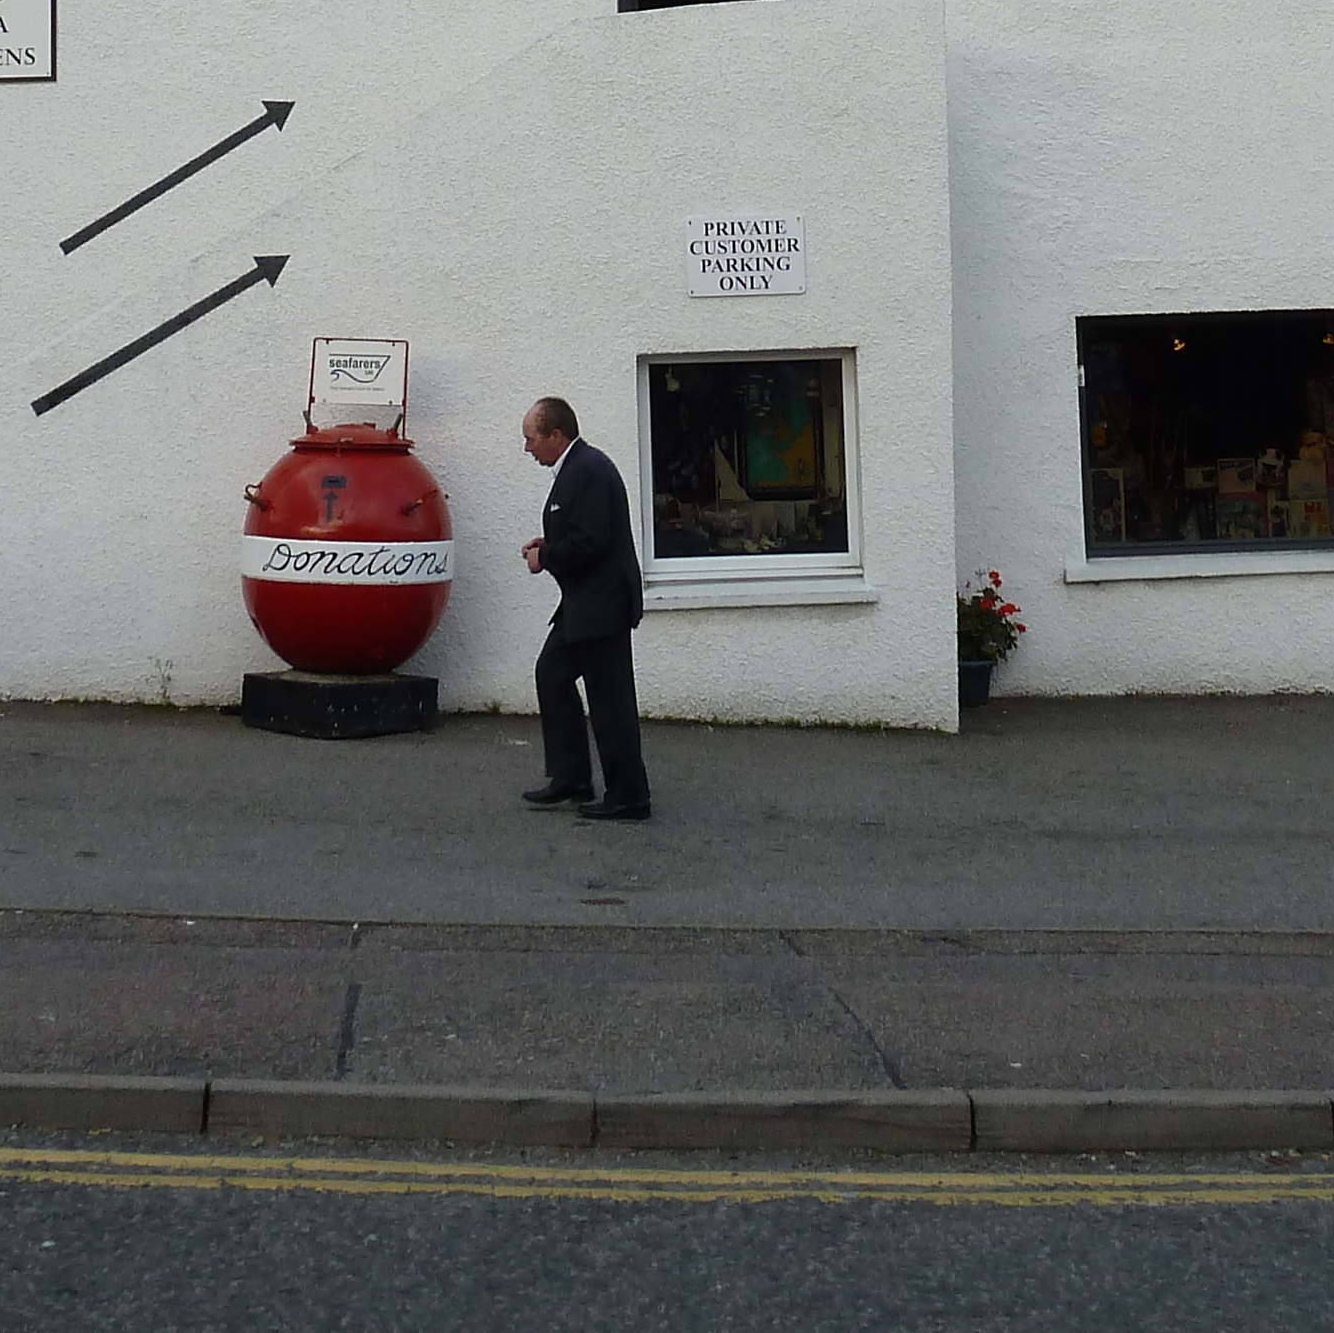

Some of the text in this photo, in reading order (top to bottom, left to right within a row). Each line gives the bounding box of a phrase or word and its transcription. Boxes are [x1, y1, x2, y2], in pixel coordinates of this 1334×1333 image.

[704, 220, 787, 237] PRIVATE
[689, 237, 800, 256] CUSTOMER
[700, 256, 791, 273] PARKING
[719, 274, 773, 291] ONLY
[329, 357, 381, 369] seafarers
[262, 543, 449, 577] Donations
